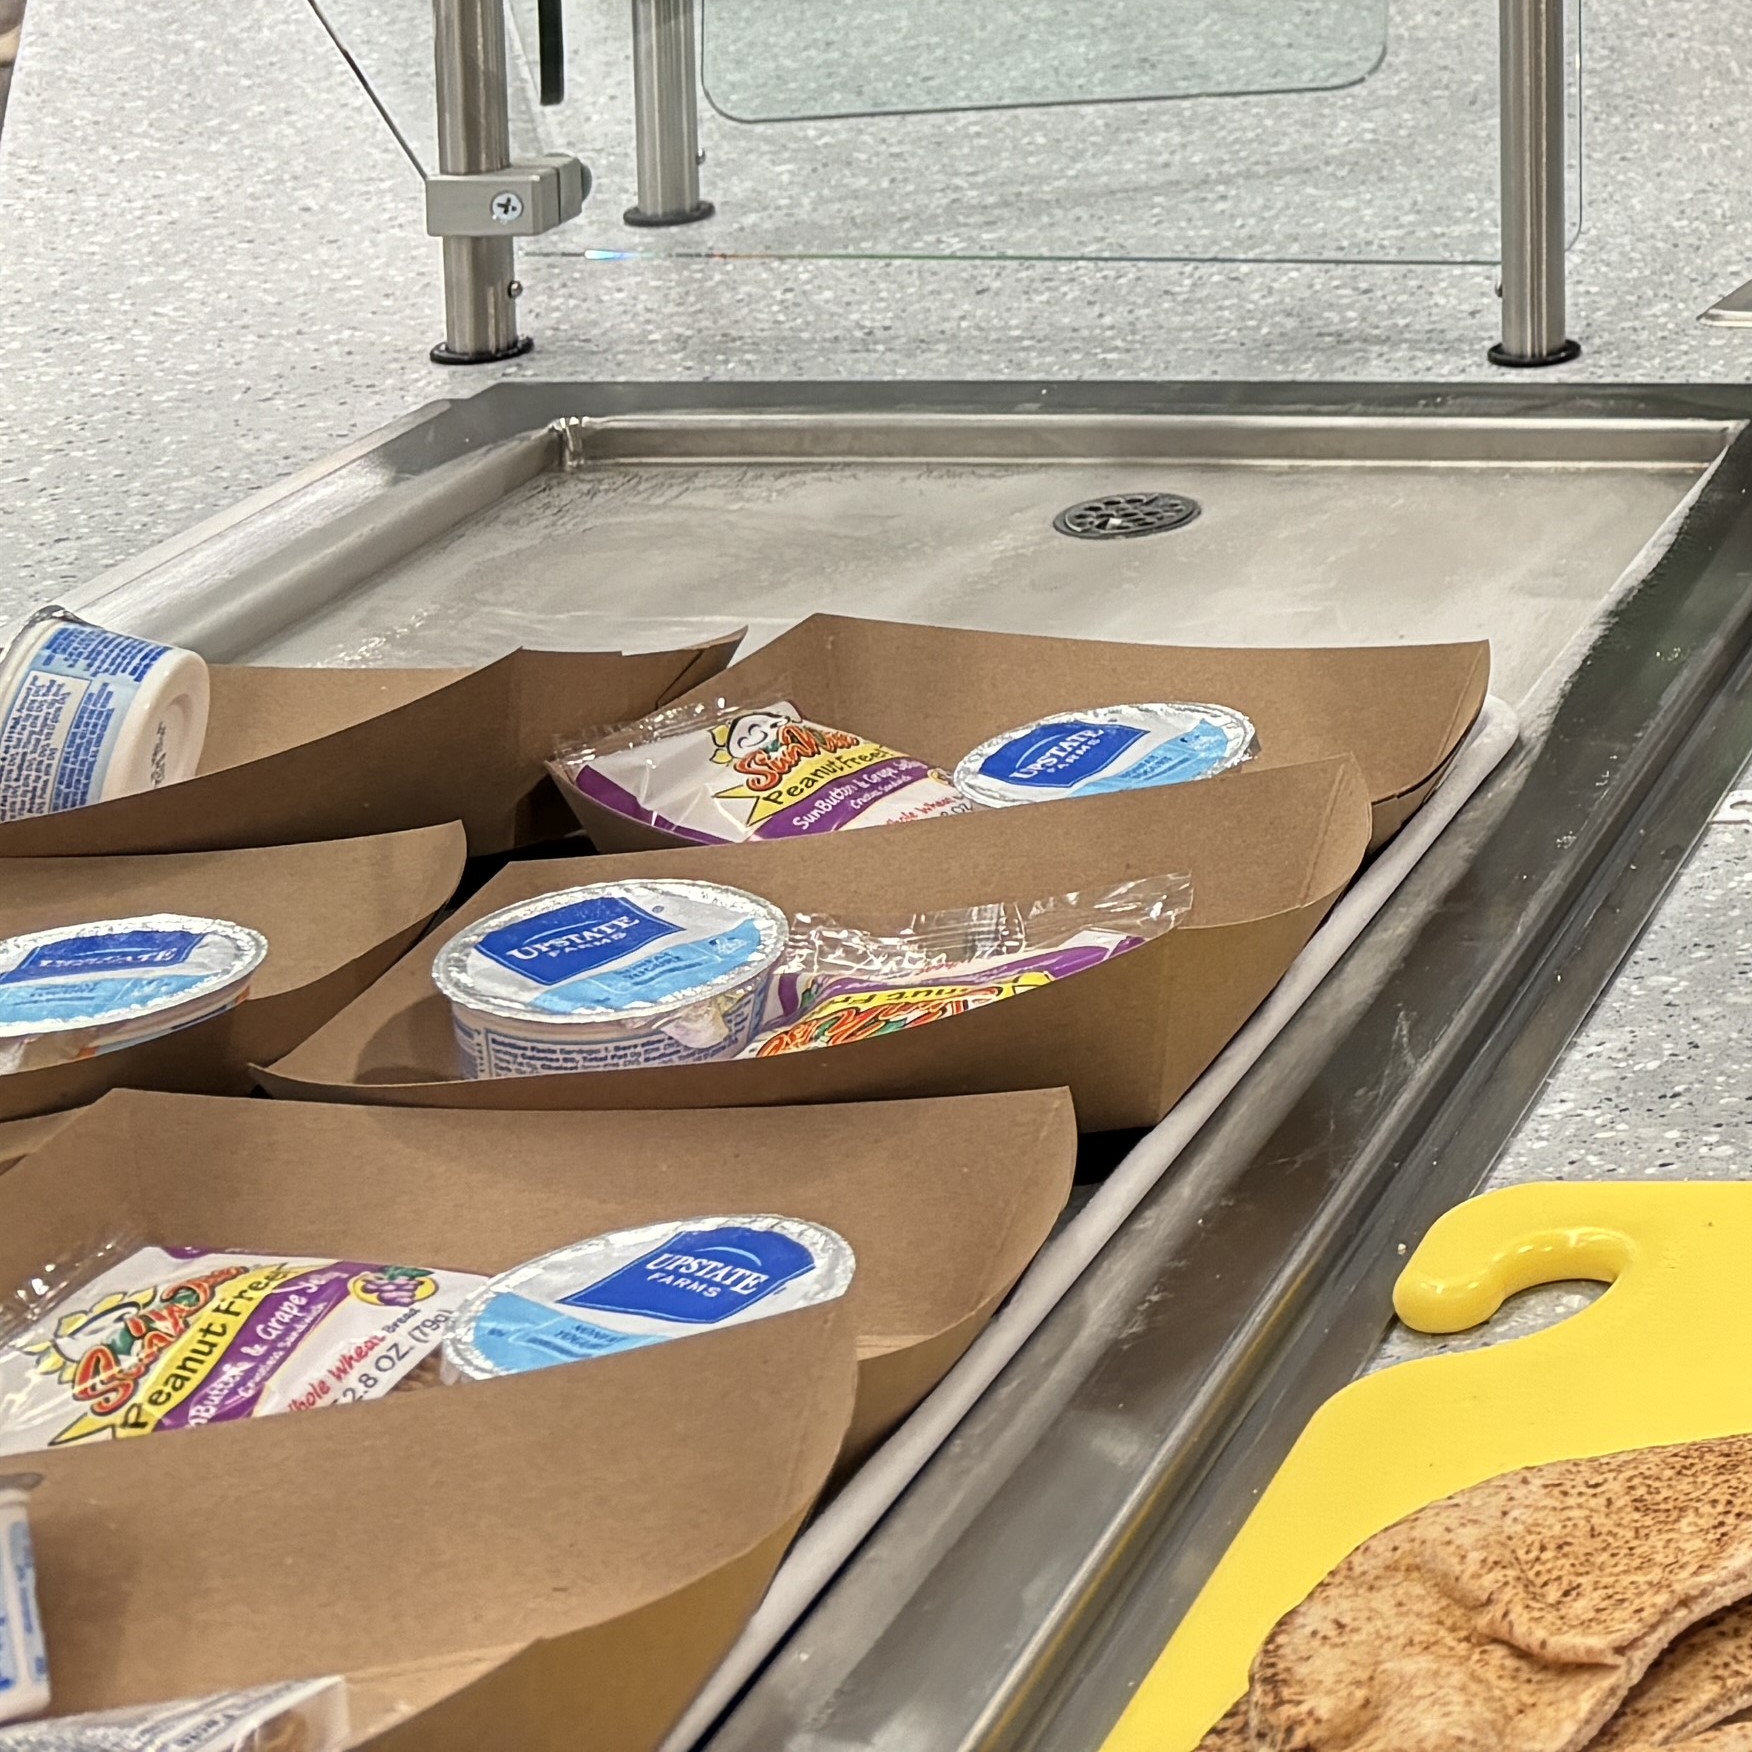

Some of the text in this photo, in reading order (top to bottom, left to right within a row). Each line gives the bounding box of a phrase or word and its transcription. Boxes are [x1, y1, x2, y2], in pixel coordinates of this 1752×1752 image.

[762, 756, 844, 805] Peanut
[505, 914, 641, 962] UPSTATE
[645, 1252, 770, 1296] UPSTATE
[646, 1271, 723, 1299] FARMS
[256, 1292, 308, 1340] Grape
[119, 1322, 230, 1431] Peanut
[327, 1334, 386, 1381] Wheat
